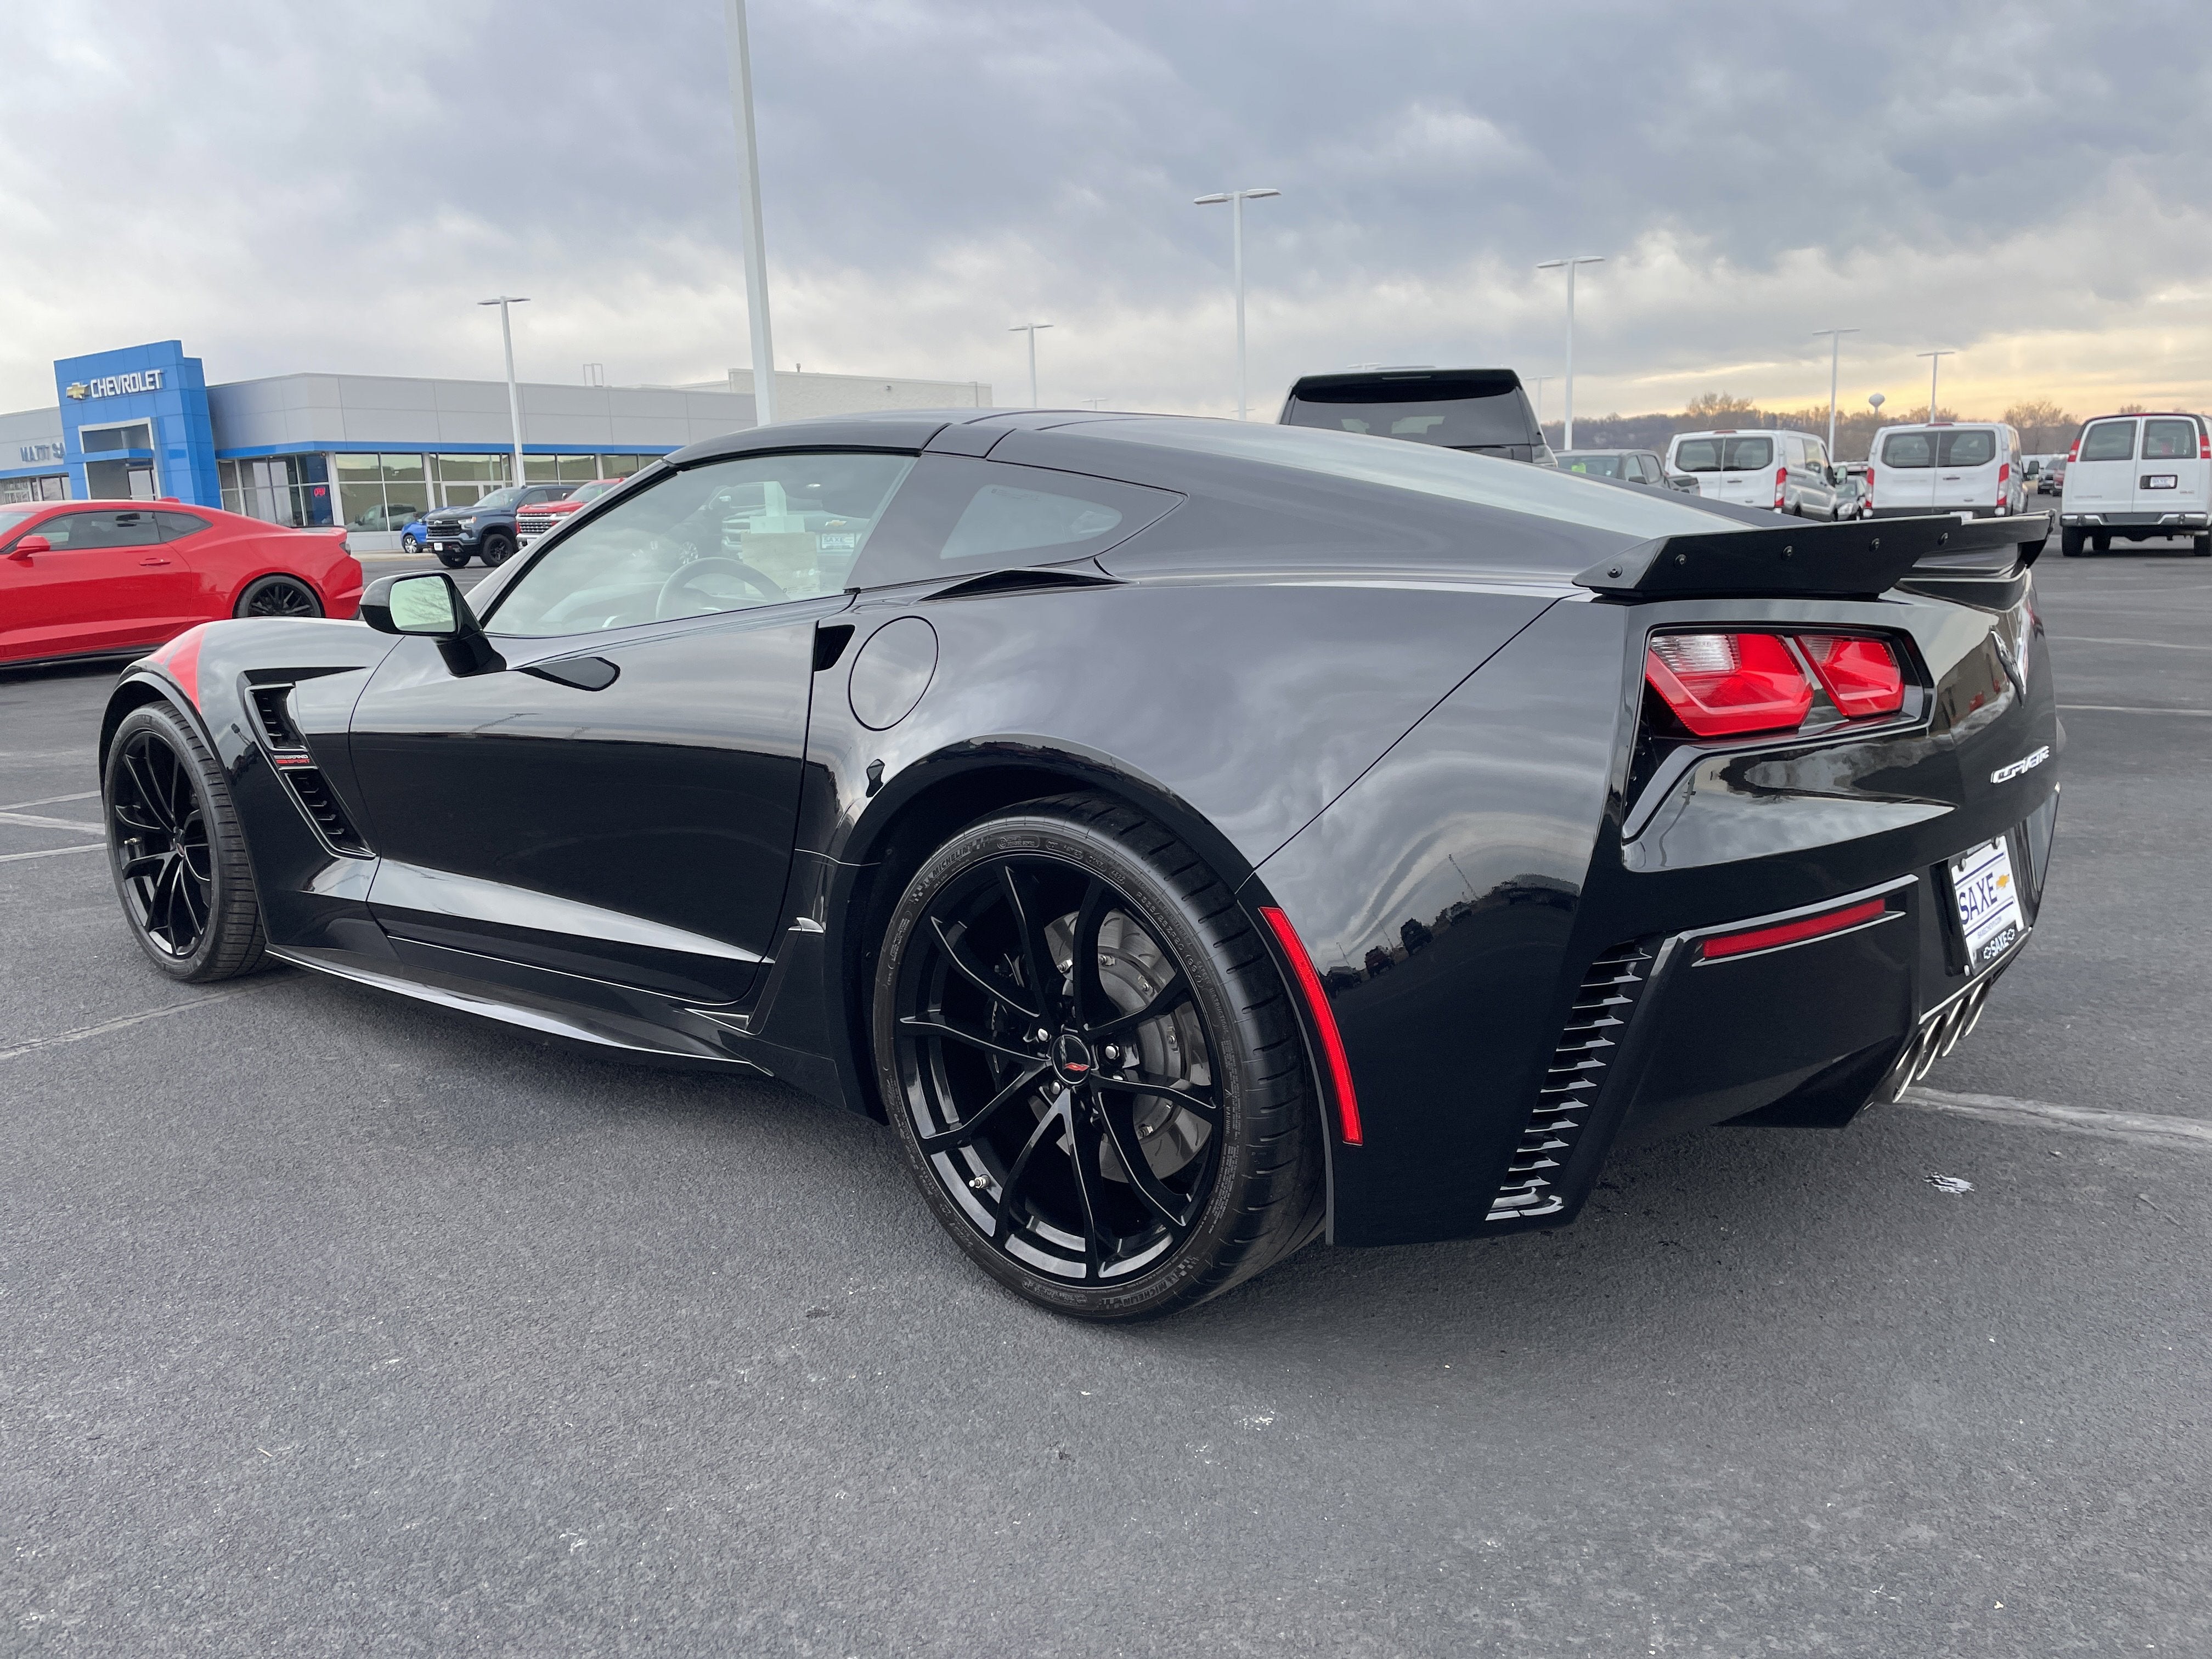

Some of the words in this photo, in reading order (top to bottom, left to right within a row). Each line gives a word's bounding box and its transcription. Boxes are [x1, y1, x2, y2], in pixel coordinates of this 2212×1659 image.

[91, 369, 161, 398] CHEVROLET
[933, 845, 970, 878] MICHELIN
[1959, 872, 1997, 925] SAXE
[1990, 931, 2010, 957] SAXE
[1124, 1280, 1169, 1306] MICHELIN
